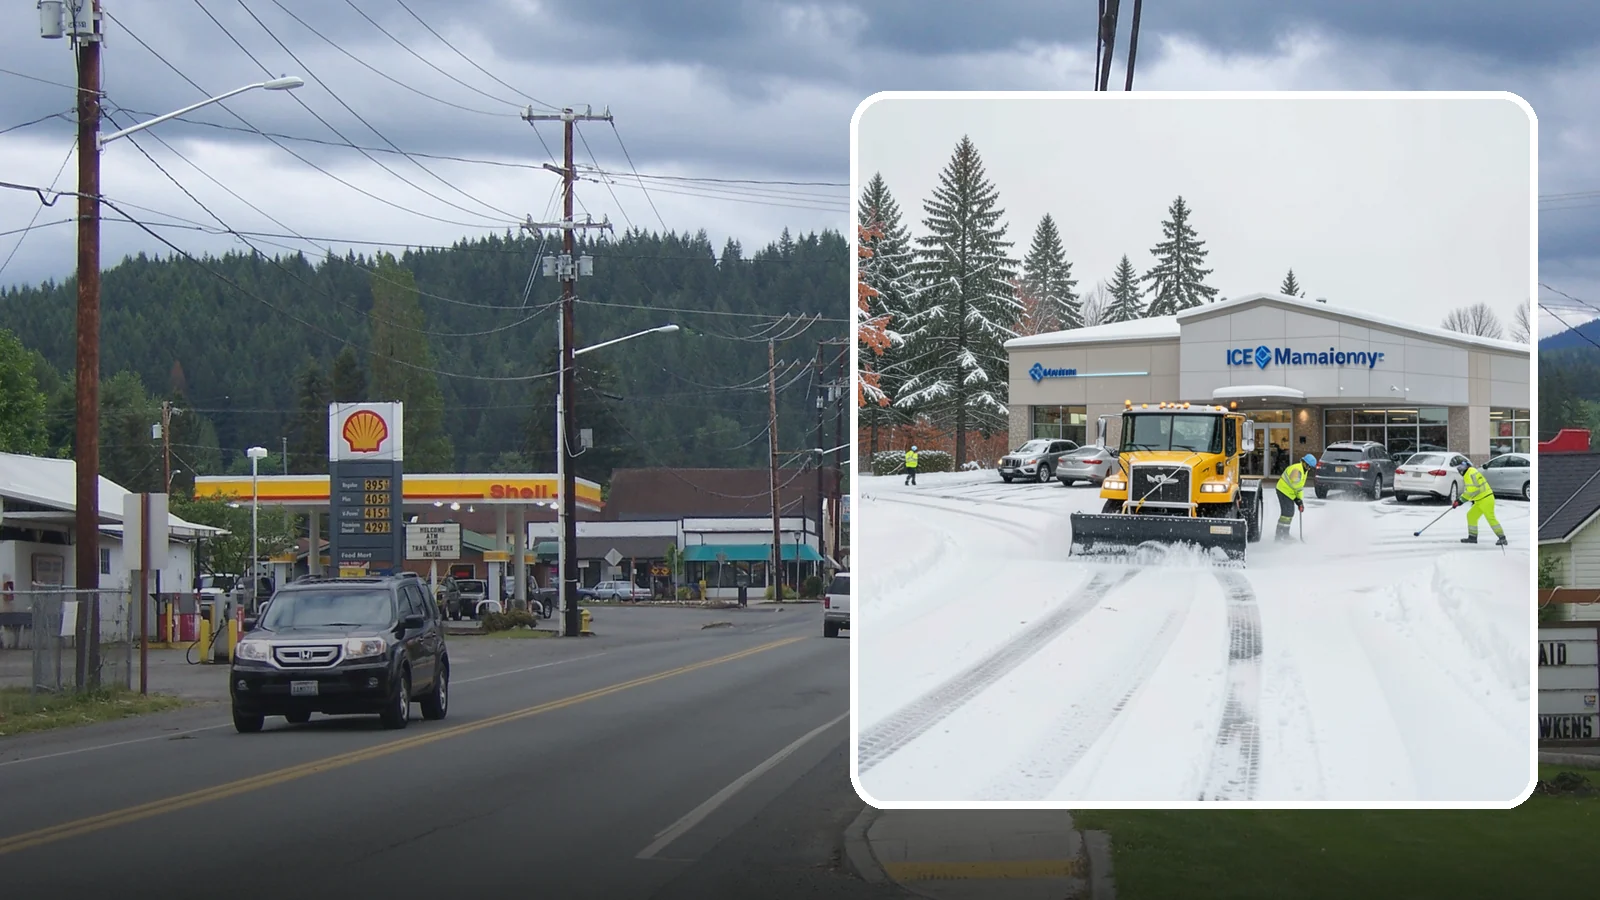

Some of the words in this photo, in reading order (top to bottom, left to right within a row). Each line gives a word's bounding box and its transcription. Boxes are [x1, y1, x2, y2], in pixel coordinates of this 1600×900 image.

[1226, 348, 1253, 366] ICE
[366, 480, 383, 490] 395
[490, 484, 547, 499] Shell
[366, 494, 383, 504] 405
[366, 508, 383, 518] 415
[366, 522, 383, 532] 429
